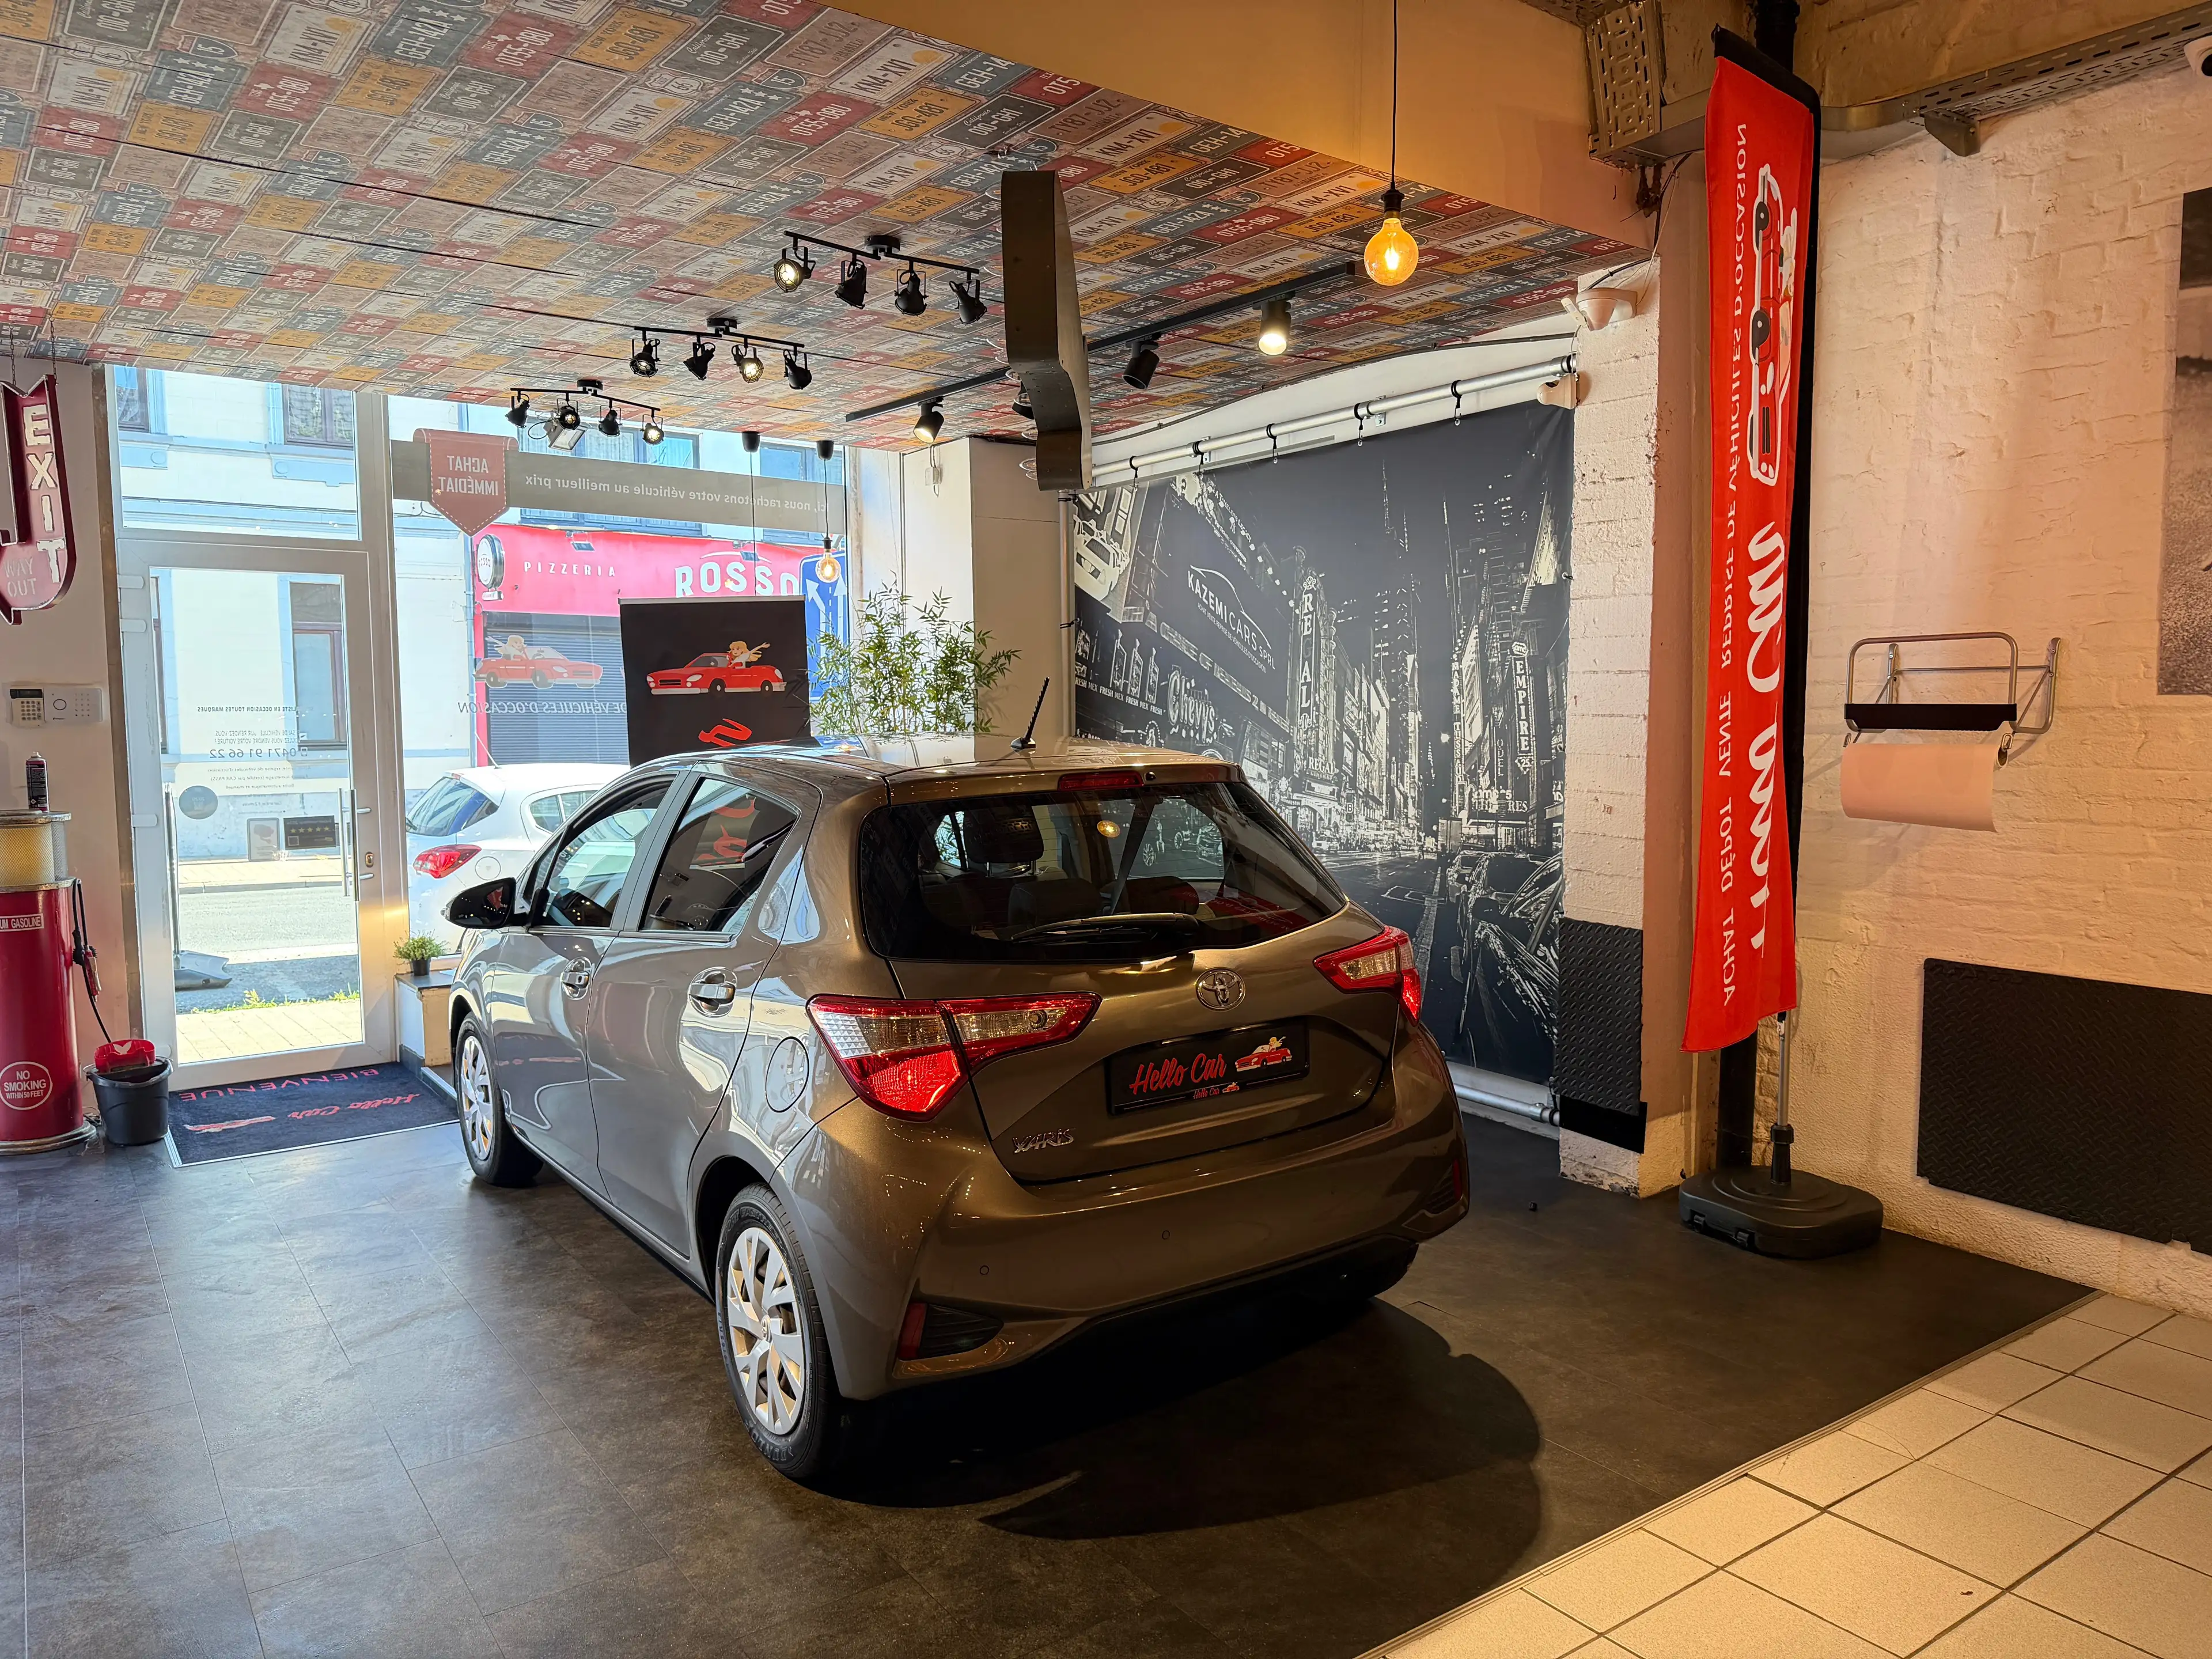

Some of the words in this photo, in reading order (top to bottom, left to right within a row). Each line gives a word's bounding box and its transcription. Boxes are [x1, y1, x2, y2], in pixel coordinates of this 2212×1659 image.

[771, 75, 796, 85] 15
[877, 109, 893, 122] NEW
[893, 98, 919, 111] YORK
[964, 109, 992, 126] California
[1027, 143, 1048, 152] 15
[23, 404, 65, 583] EXIT
[3, 557, 33, 577] WAY
[524, 561, 616, 577] PIZZERIA
[7, 578, 36, 597] OUT
[1188, 570, 1227, 623] KAZEMI
[1229, 612, 1257, 651] CARS
[1259, 646, 1276, 670] SPRL
[1300, 592, 1314, 709] REGAL
[1075, 677, 1087, 688] RESH
[1100, 685, 1113, 697] FRESH
[1126, 695, 1139, 707] FRESH
[1150, 704, 1162, 715] FRESH
[1515, 660, 1530, 751] EMPIRE
[1308, 756, 1336, 775] REGAL
[11, 916, 41, 929] GASOLINE
[16, 1070, 30, 1080] NO
[1130, 1058, 1188, 1094] Hello
[1191, 1053, 1227, 1083] Car
[4, 1079, 46, 1092] SMOKING
[30, 1090, 44, 1098] FEET
[179, 1068, 379, 1103] BIENVENUE
[347, 1093, 421, 1110] Hello
[1012, 1128, 1074, 1153] YARIS
